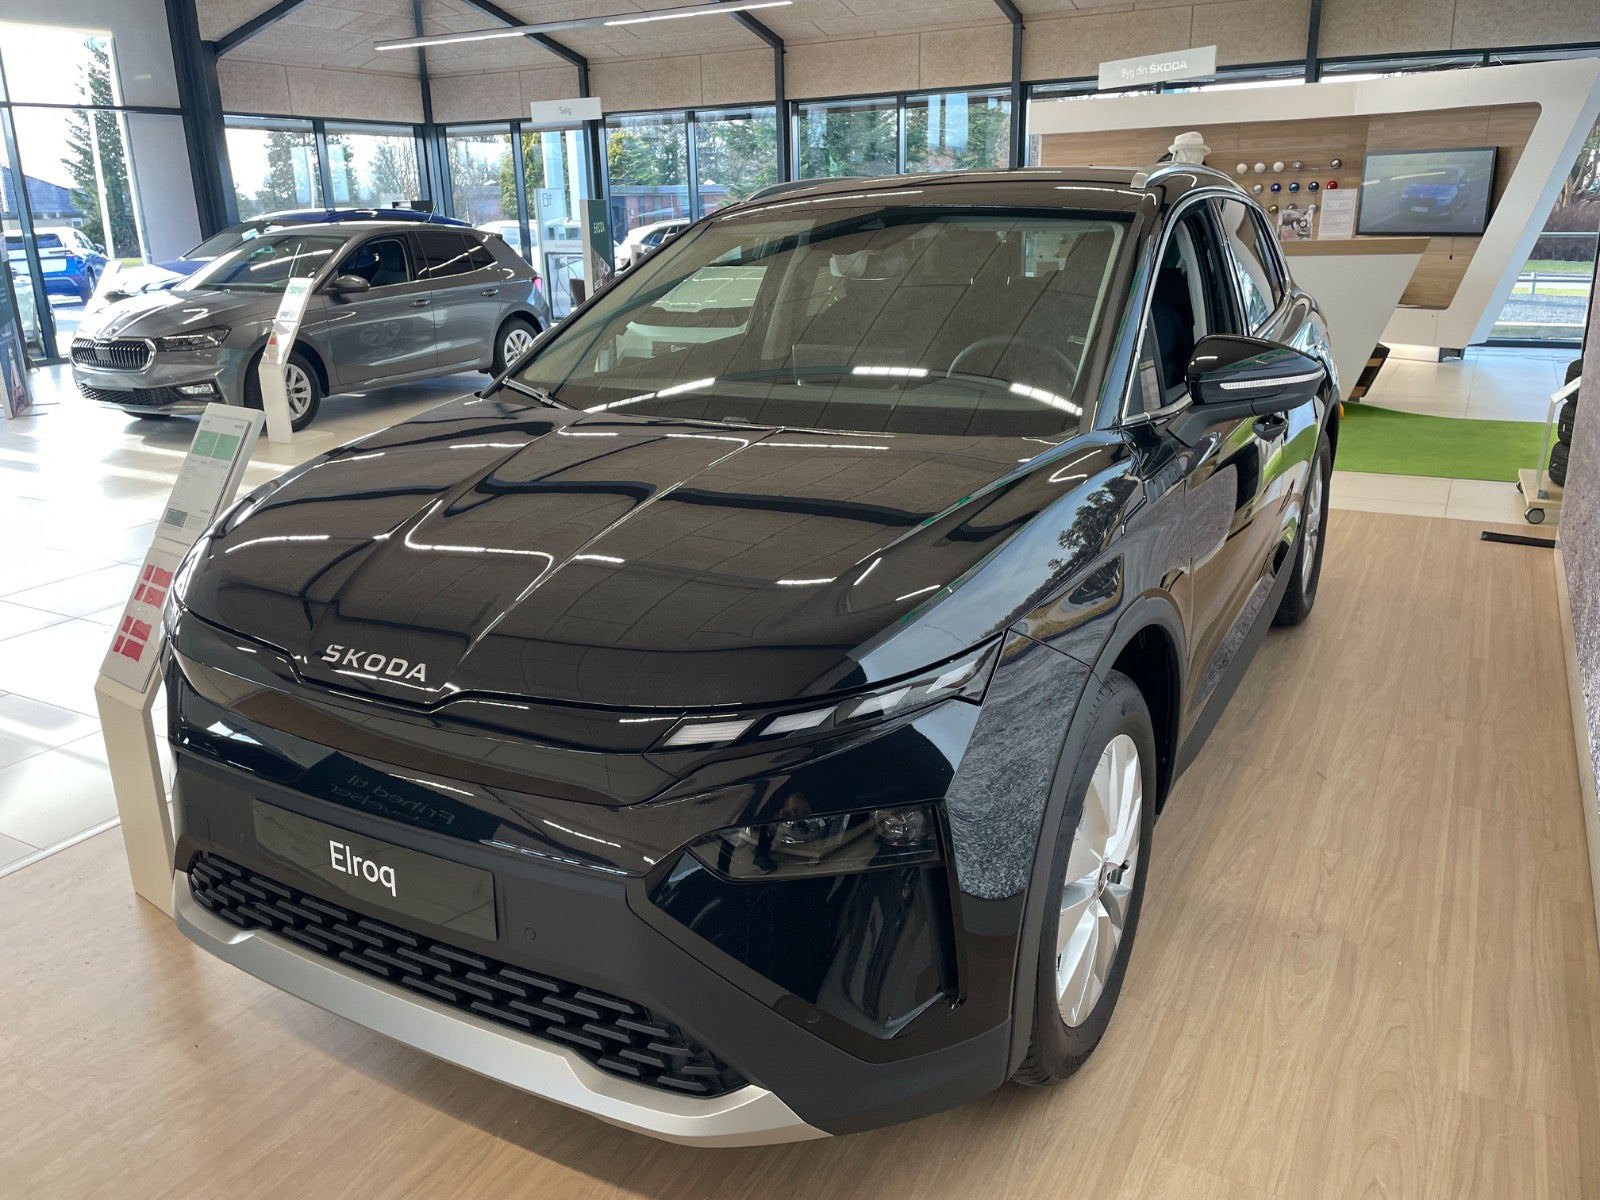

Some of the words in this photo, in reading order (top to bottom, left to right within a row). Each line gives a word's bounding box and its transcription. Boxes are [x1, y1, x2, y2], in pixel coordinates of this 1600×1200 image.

[1120, 67, 1135, 79] Byg
[1136, 64, 1148, 76] din
[329, 840, 397, 898] Elroq
